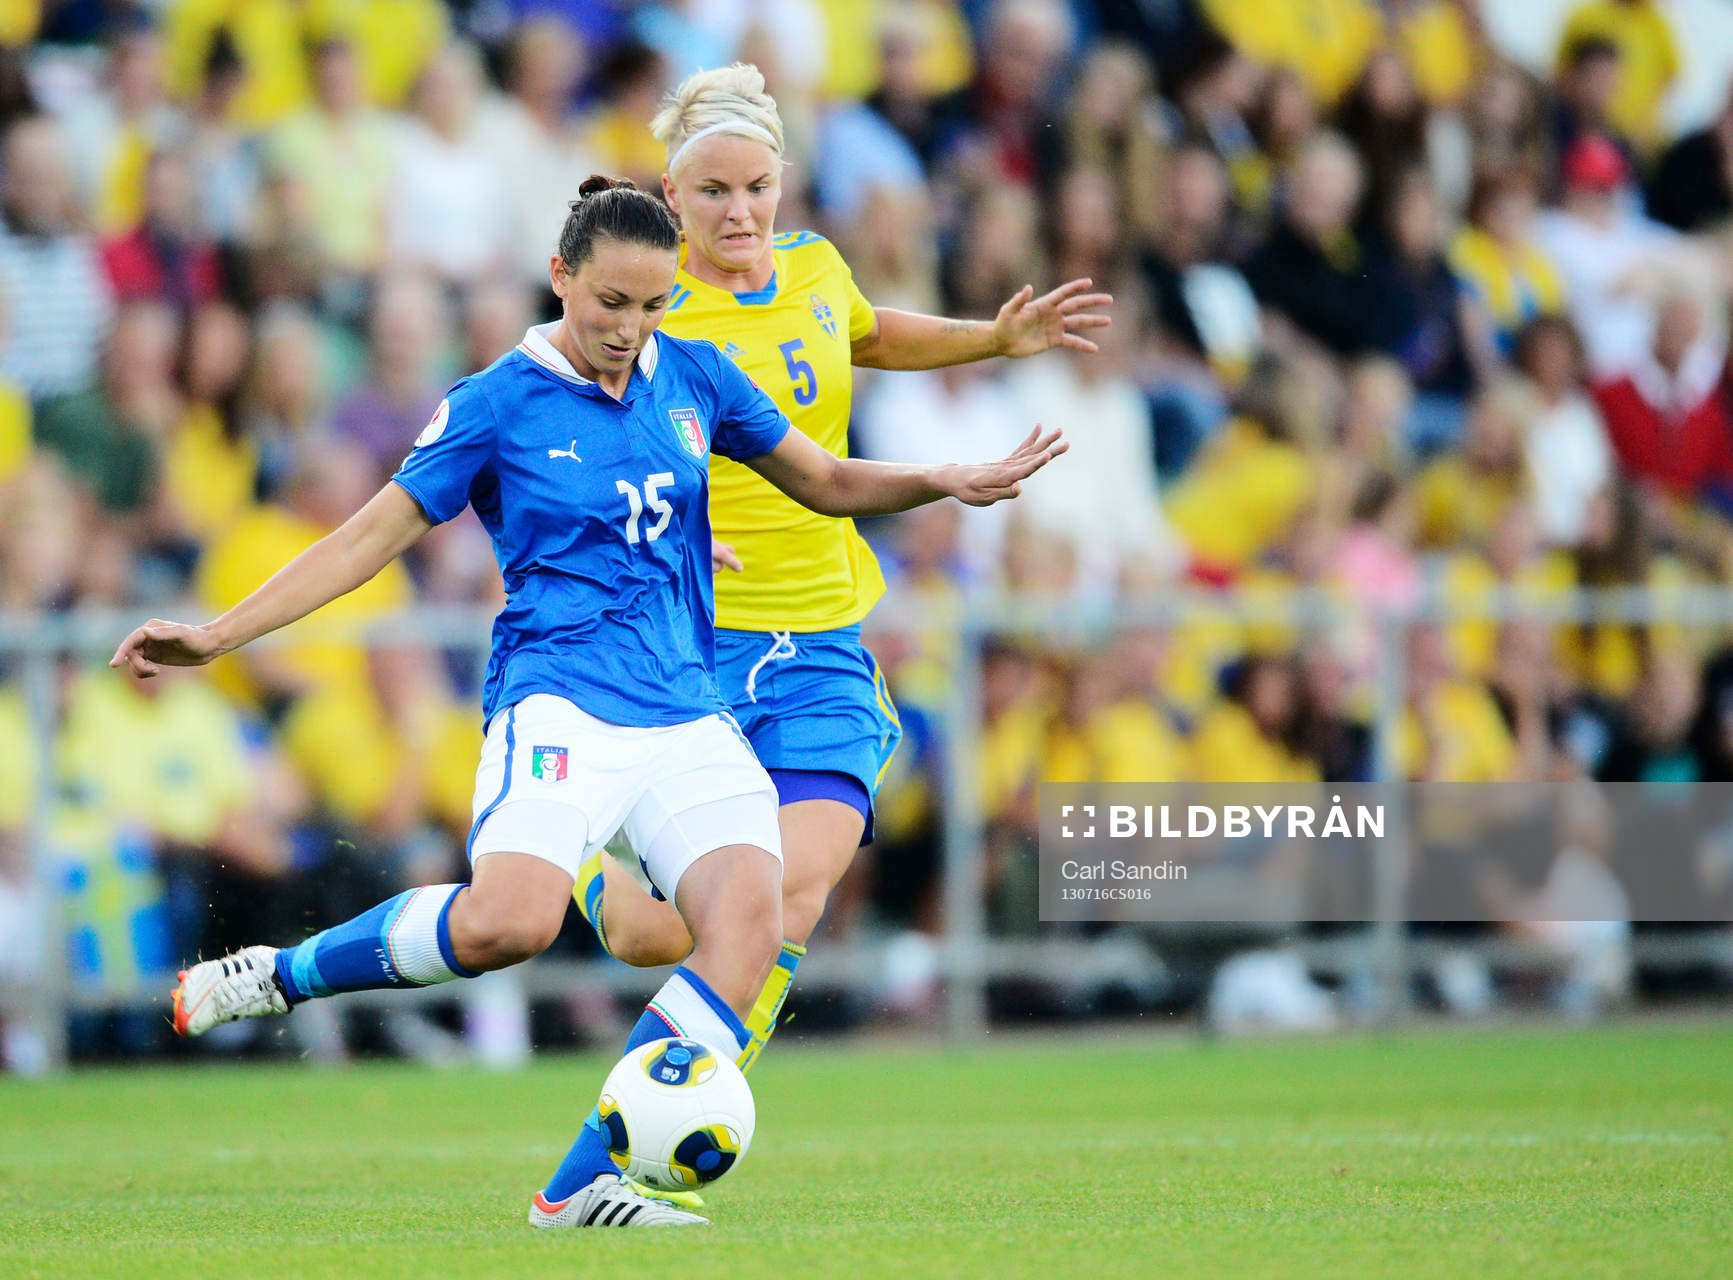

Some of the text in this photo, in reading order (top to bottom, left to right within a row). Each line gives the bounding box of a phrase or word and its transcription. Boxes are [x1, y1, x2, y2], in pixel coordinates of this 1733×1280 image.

[778, 338, 818, 406] 5
[672, 412, 694, 420] ITALIA
[615, 471, 676, 545] 15
